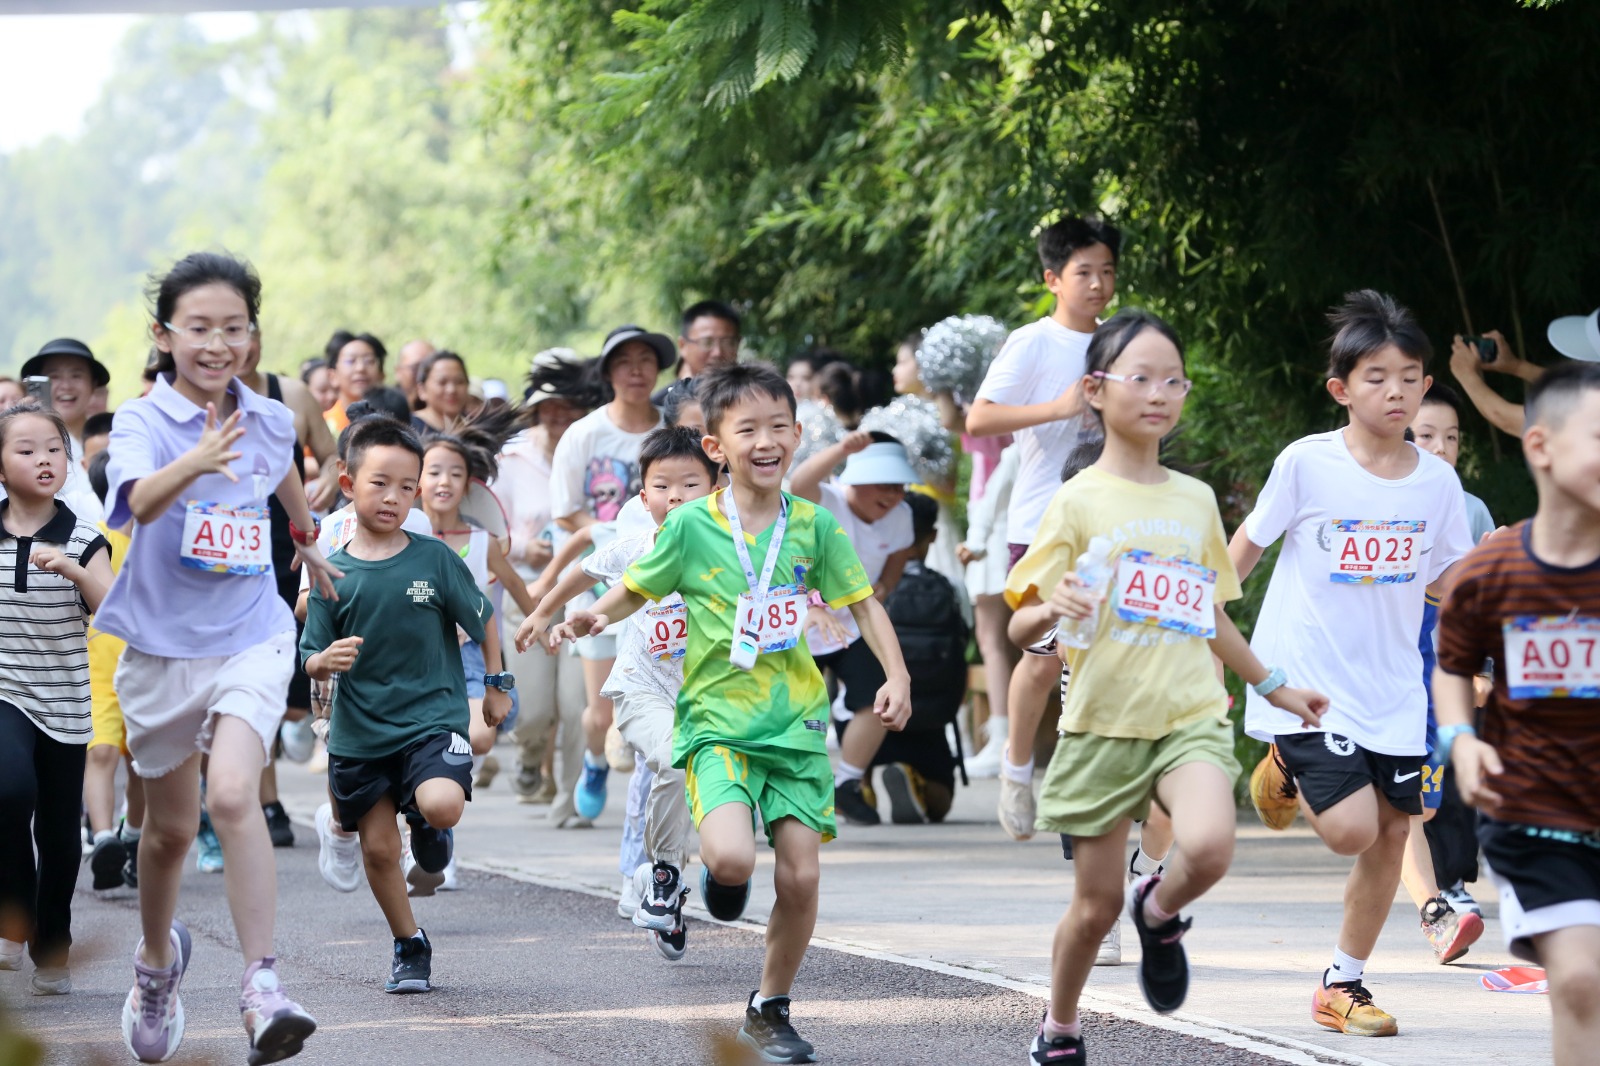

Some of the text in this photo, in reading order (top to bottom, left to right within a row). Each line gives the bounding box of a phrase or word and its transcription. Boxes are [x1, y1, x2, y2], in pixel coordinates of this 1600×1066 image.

[1340, 536, 1413, 562] A023
[406, 587, 435, 596] ATHLETIC
[412, 580, 429, 588] NIKE
[1125, 569, 1204, 612] A082
[650, 618, 688, 645] 02
[740, 600, 798, 641] 085
[1421, 764, 1445, 793] 24
